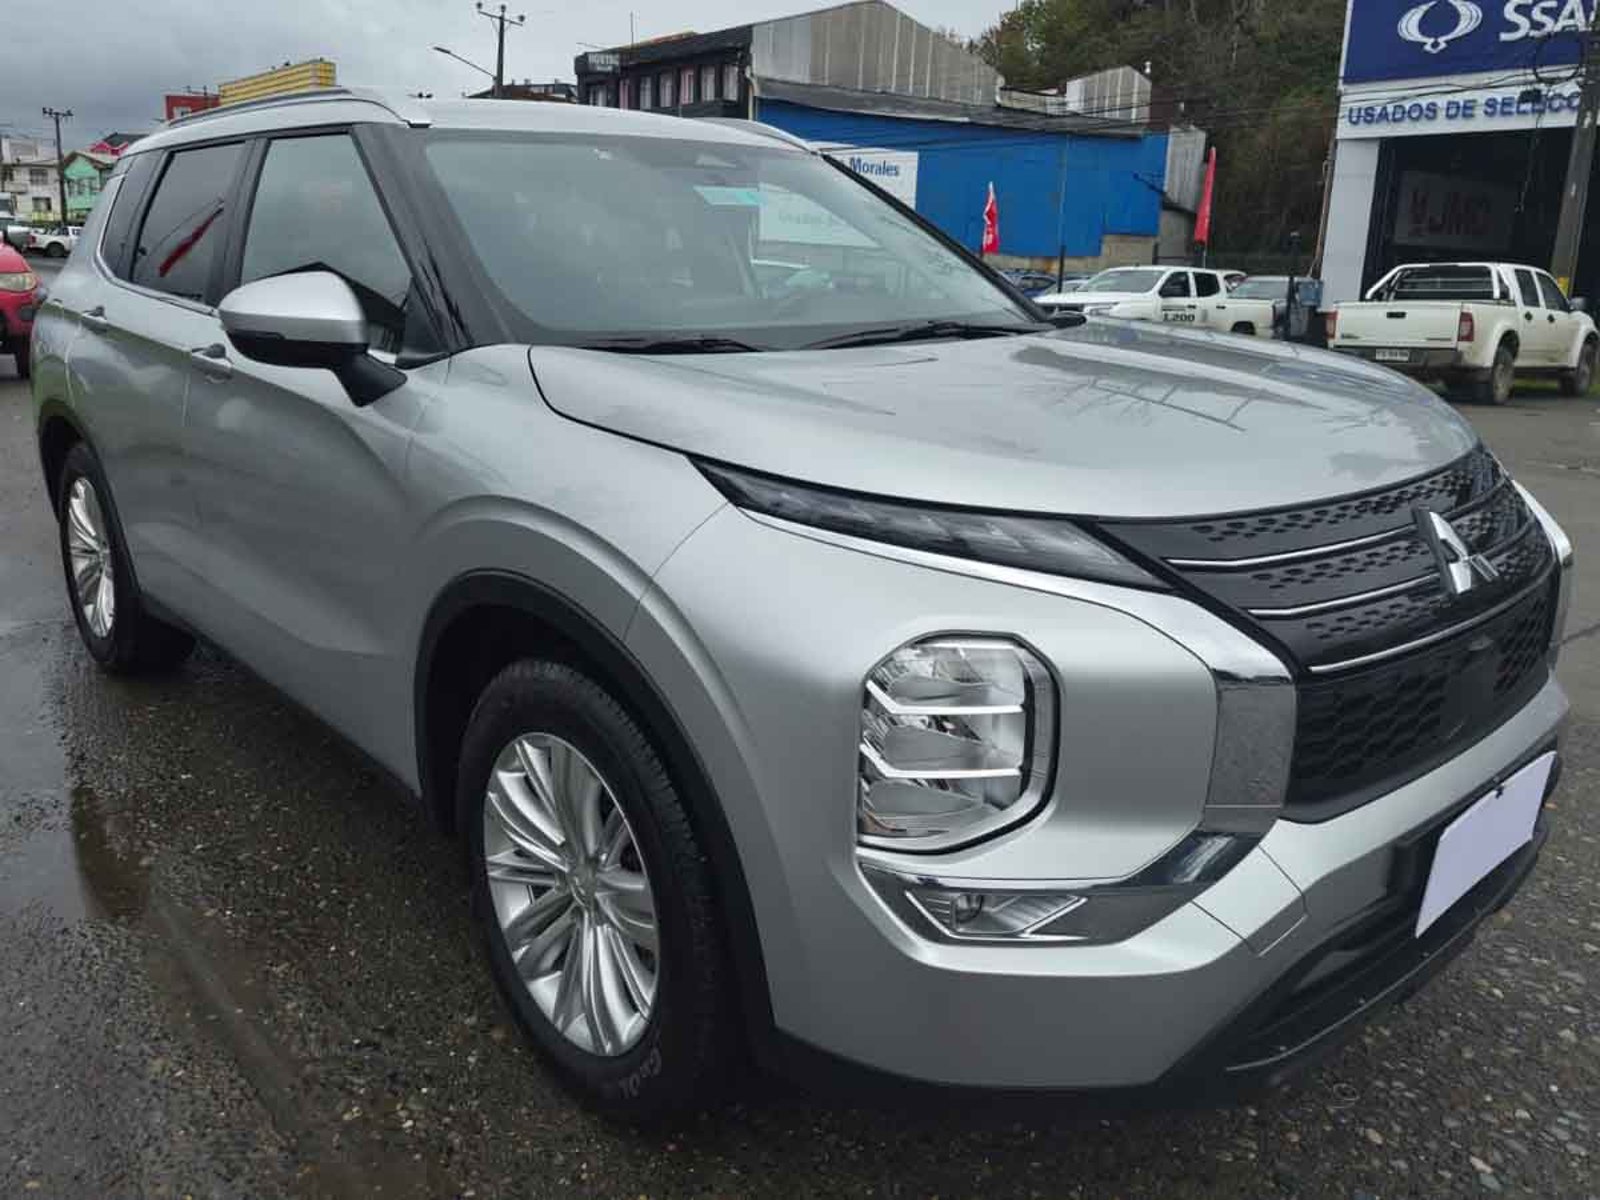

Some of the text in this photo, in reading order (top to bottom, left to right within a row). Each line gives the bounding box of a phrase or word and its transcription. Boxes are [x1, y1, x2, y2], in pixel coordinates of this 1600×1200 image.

[1499, 0, 1597, 41] SSA
[1348, 101, 1437, 125] USADOS
[1446, 99, 1476, 119] DE
[850, 157, 899, 176] Morales
